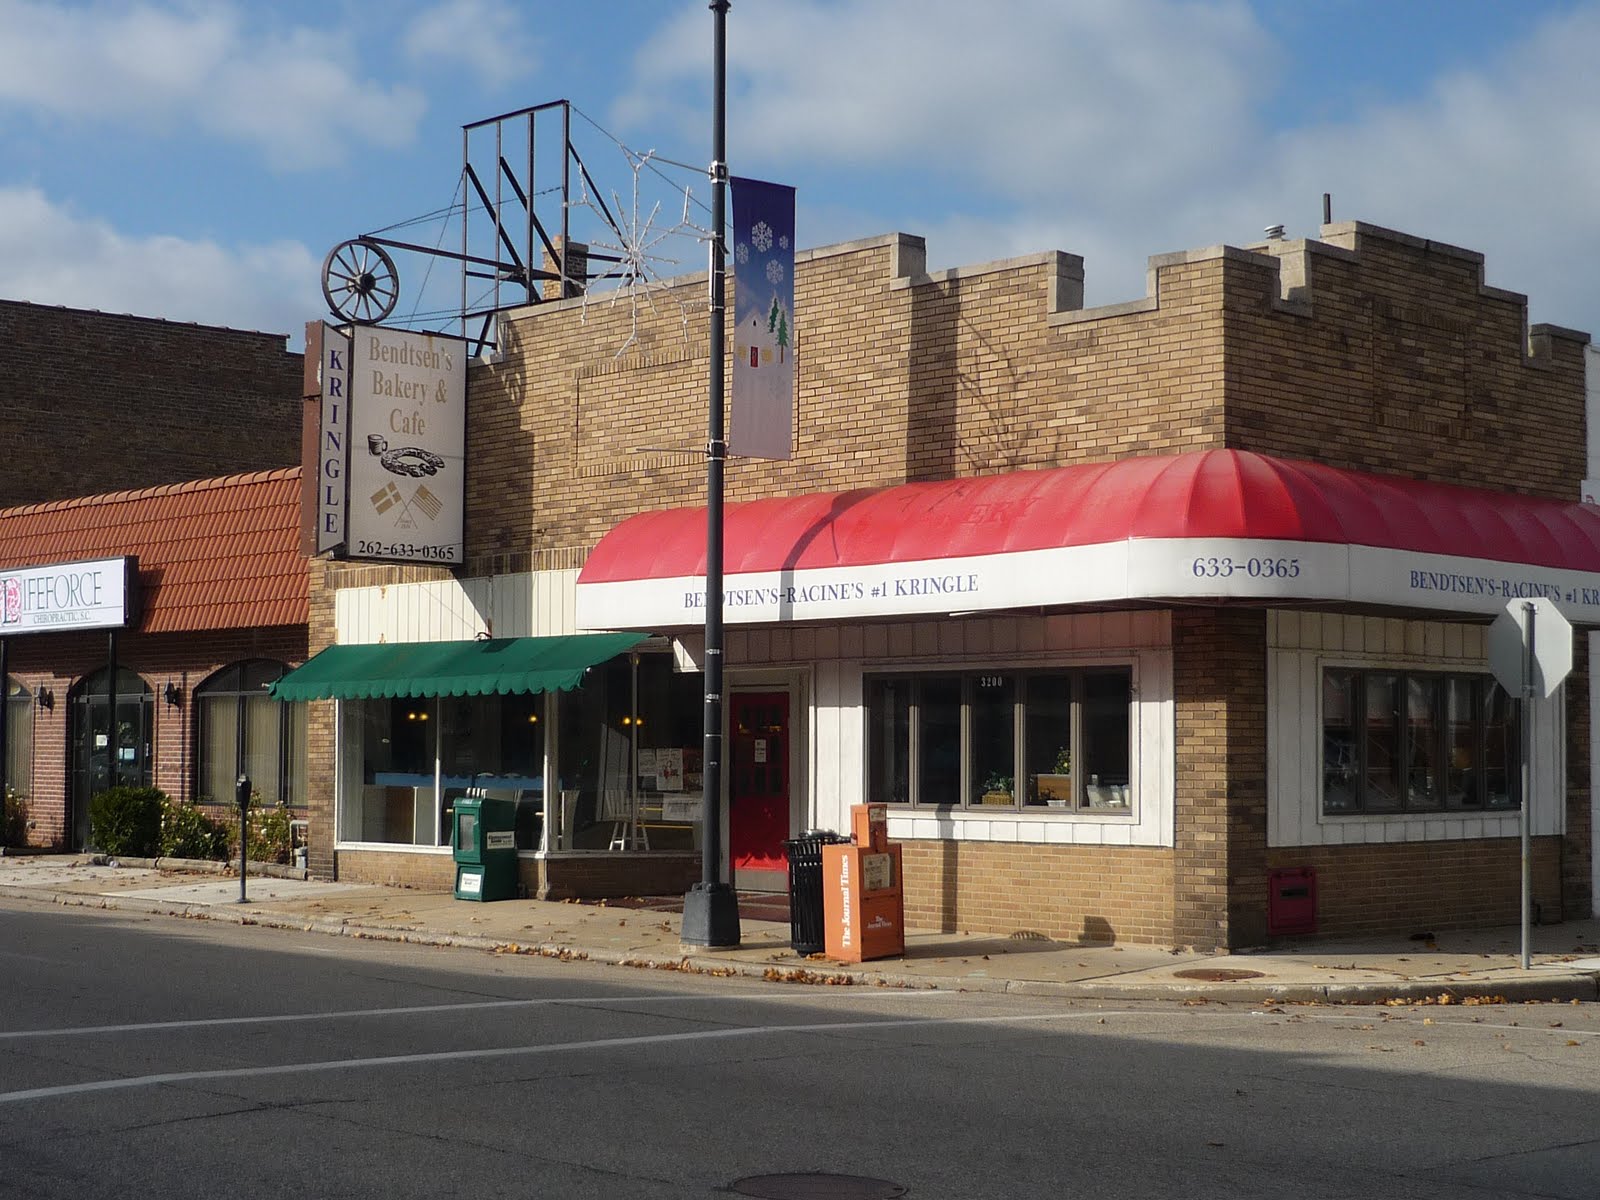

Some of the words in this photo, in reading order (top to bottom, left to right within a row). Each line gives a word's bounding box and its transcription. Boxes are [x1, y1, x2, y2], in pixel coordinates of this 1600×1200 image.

[368, 336, 453, 371] Bendtsen's
[372, 370, 429, 406] Bakery
[435, 378, 447, 404] &
[389, 408, 425, 436] Cafe
[324, 350, 344, 533] KRINGLE
[358, 540, 455, 560] 262-633-0365
[1192, 557, 1300, 579] 633-0365
[684, 582, 864, 609] BETSEN'S-RACINE'S
[871, 581, 888, 598] #1
[894, 574, 979, 597] KRINGLE
[1409, 569, 1561, 602] BENDTSEN'S-RACINE'S
[1565, 587, 1577, 603] #1
[840, 854, 849, 885] Times
[841, 887, 850, 926] Journal
[842, 926, 851, 947] The
